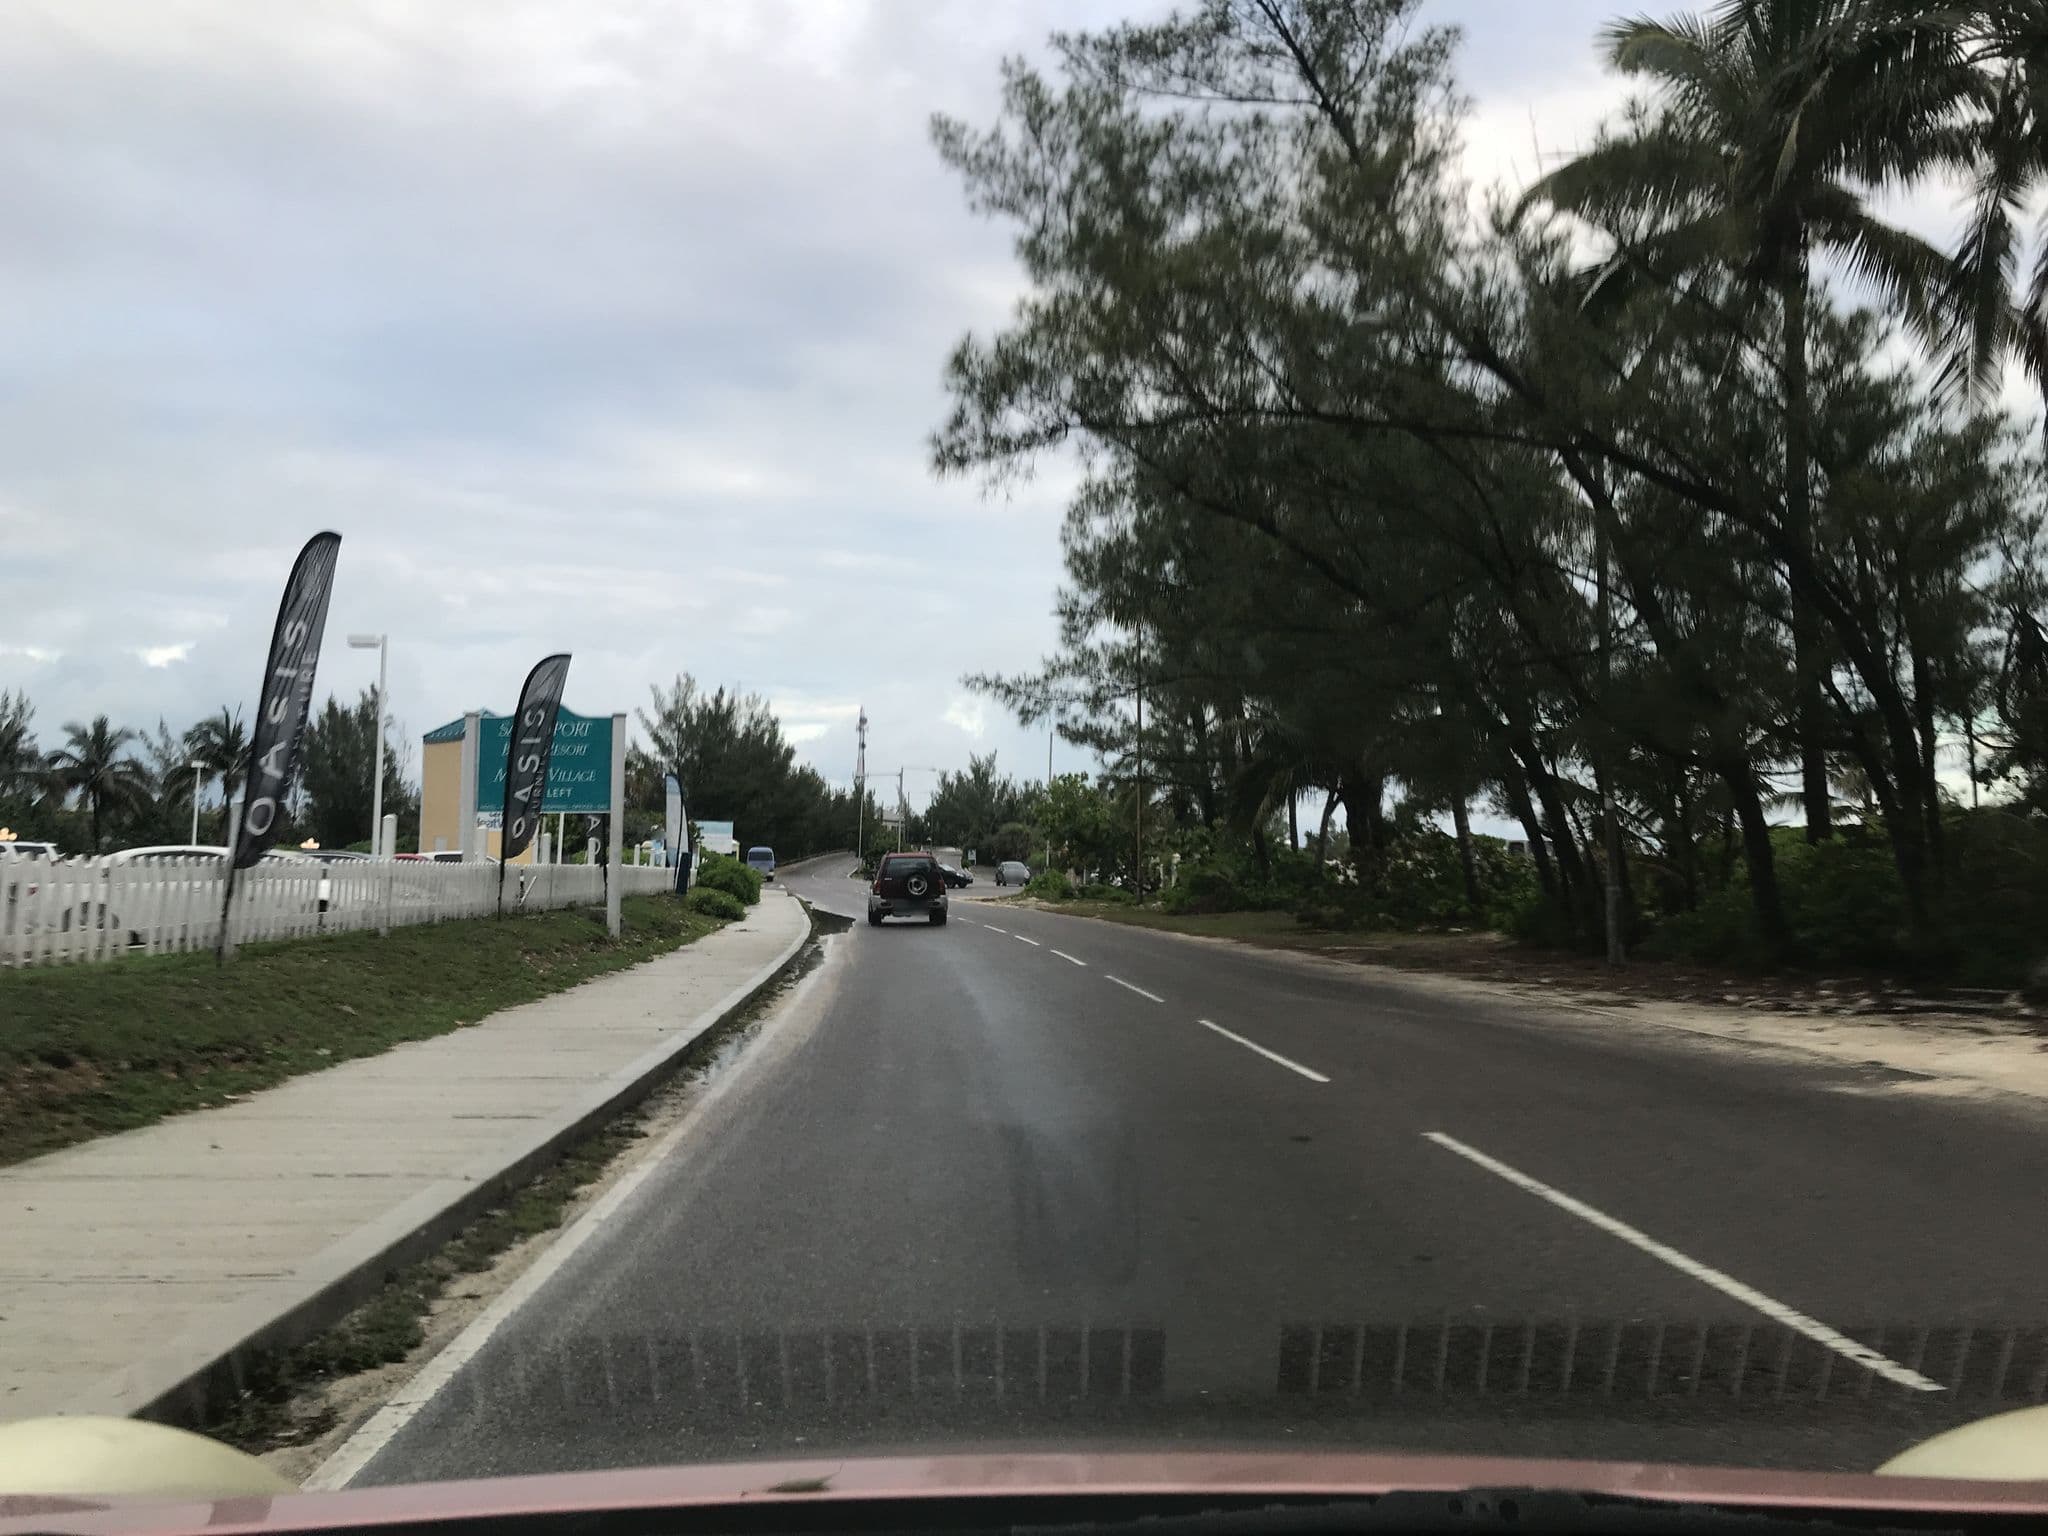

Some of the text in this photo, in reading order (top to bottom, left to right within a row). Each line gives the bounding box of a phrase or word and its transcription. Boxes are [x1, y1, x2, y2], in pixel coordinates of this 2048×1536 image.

[246, 619, 307, 837] OASIS
[512, 708, 546, 839] OASIS
[546, 788, 573, 799] LEFT
[548, 768, 597, 782] VILLAGE
